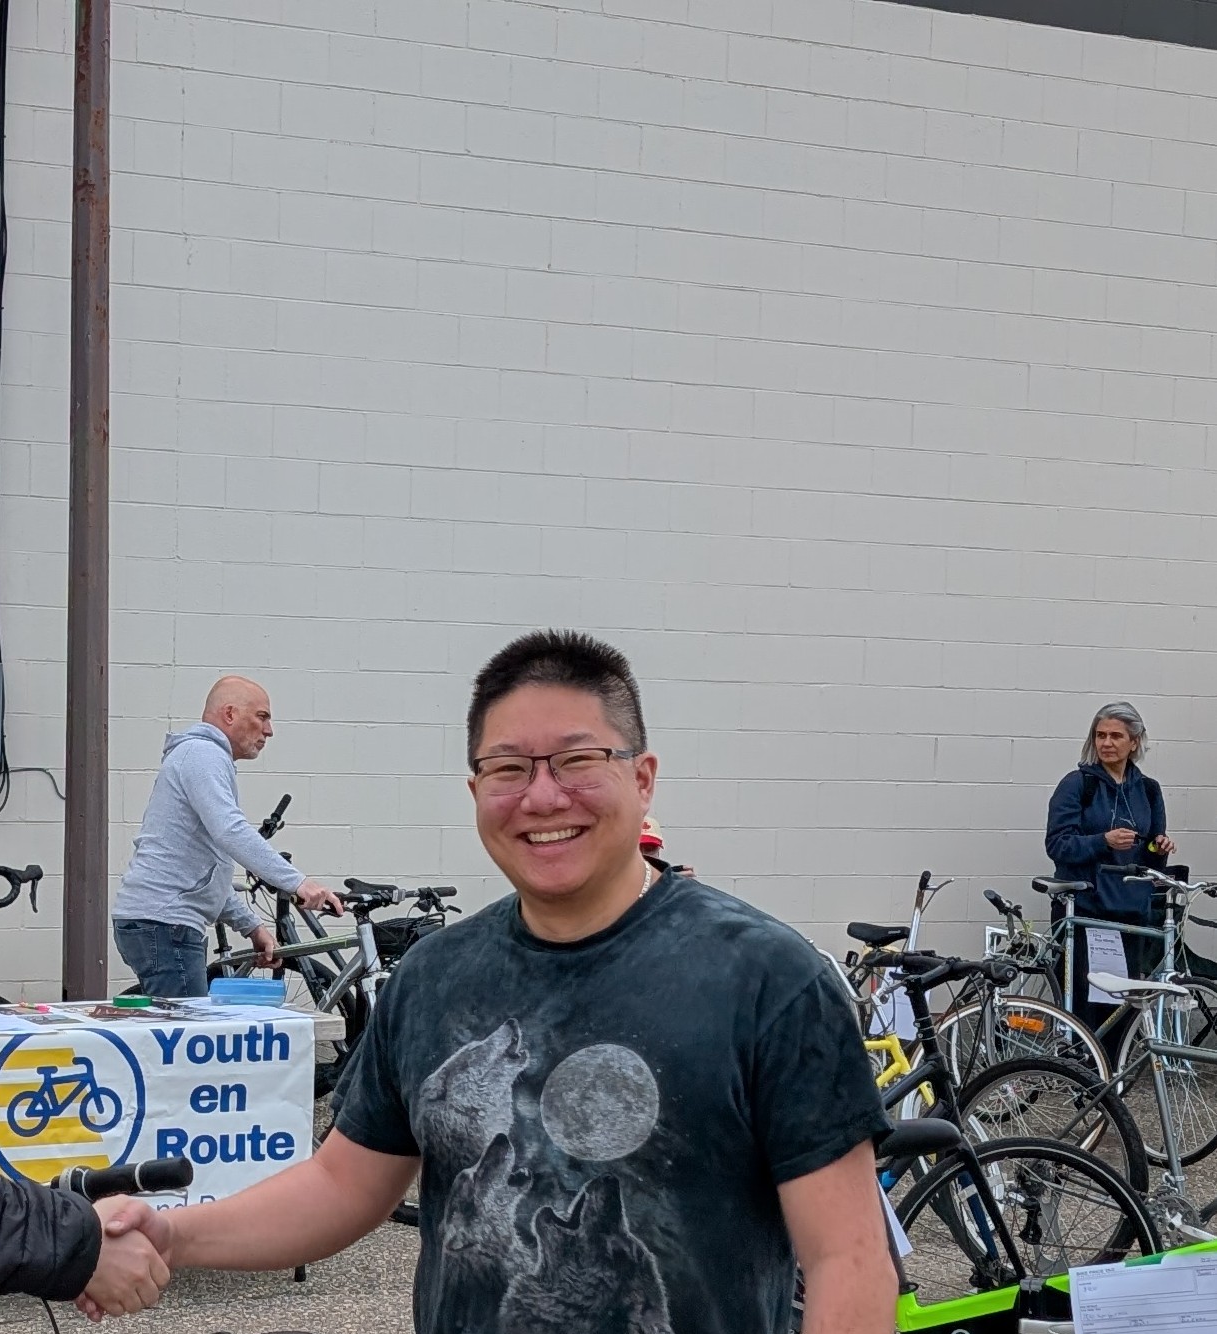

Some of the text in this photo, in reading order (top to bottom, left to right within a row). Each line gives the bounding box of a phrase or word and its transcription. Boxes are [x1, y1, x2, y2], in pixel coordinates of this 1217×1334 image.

[150, 1022, 289, 1064] Youth
[189, 1083, 247, 1114] en
[156, 1124, 295, 1164] Route
